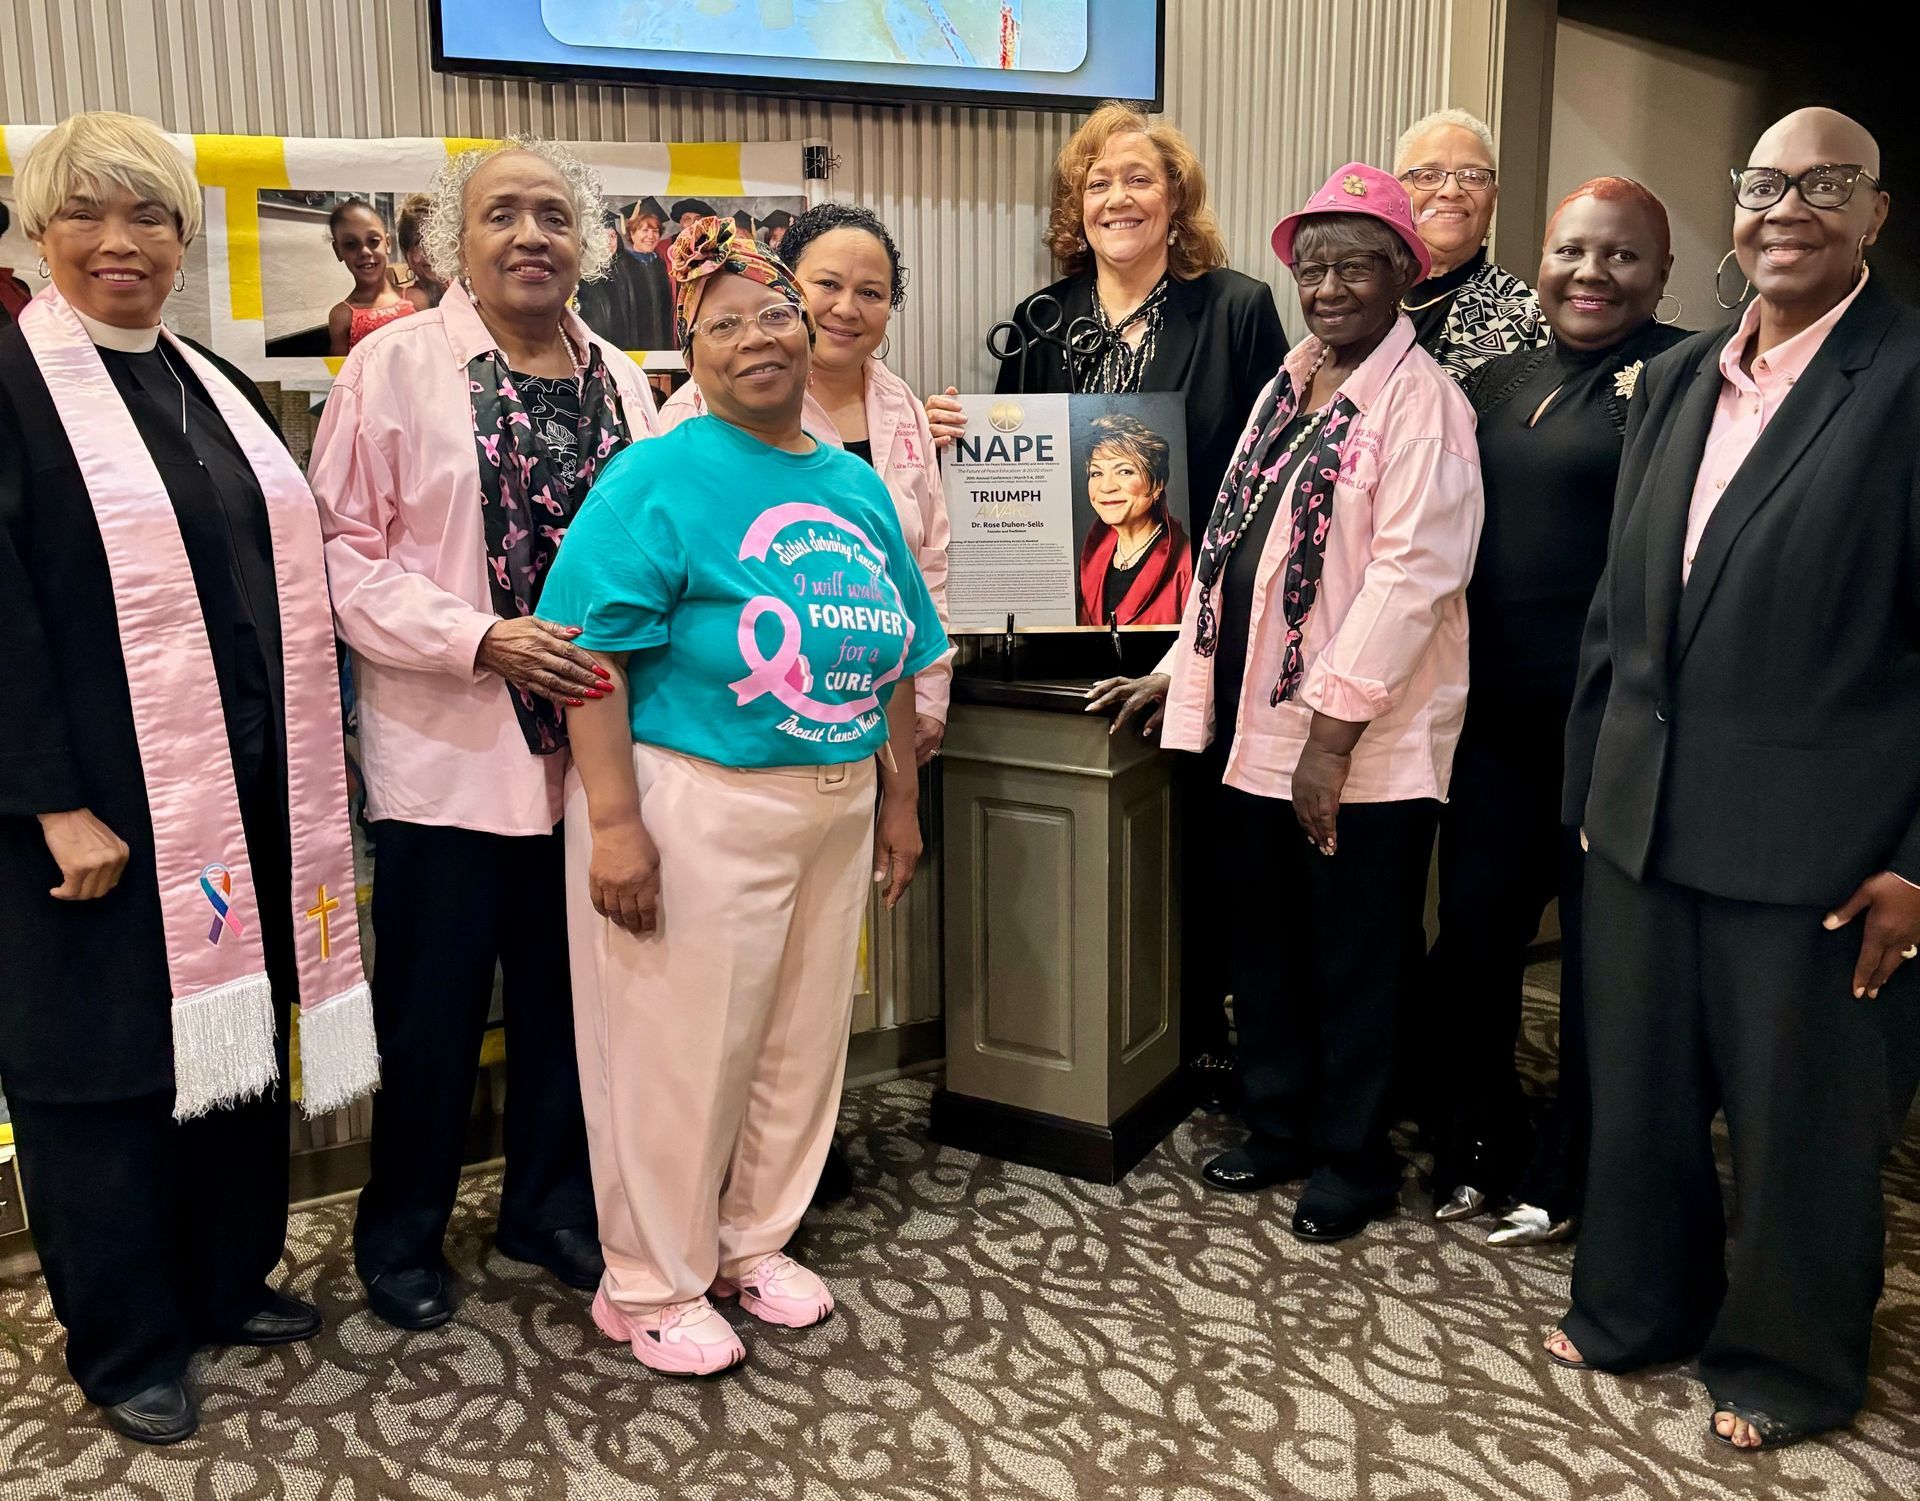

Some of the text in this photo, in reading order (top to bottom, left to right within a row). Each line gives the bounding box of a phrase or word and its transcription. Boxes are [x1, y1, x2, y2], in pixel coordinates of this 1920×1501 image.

[955, 434, 1054, 463] NAPE
[970, 490, 1041, 503] TRIUMPH
[1001, 520, 1044, 528] Duhon-Sells
[772, 528, 882, 577] Sisters Surviving Cancer
[793, 573, 806, 597] I
[811, 571, 843, 597] will
[808, 603, 903, 636] FOREVER
[831, 635, 879, 668] for a
[825, 671, 872, 692] CURE
[775, 714, 826, 742] Breast
[827, 724, 862, 743] Cancer
